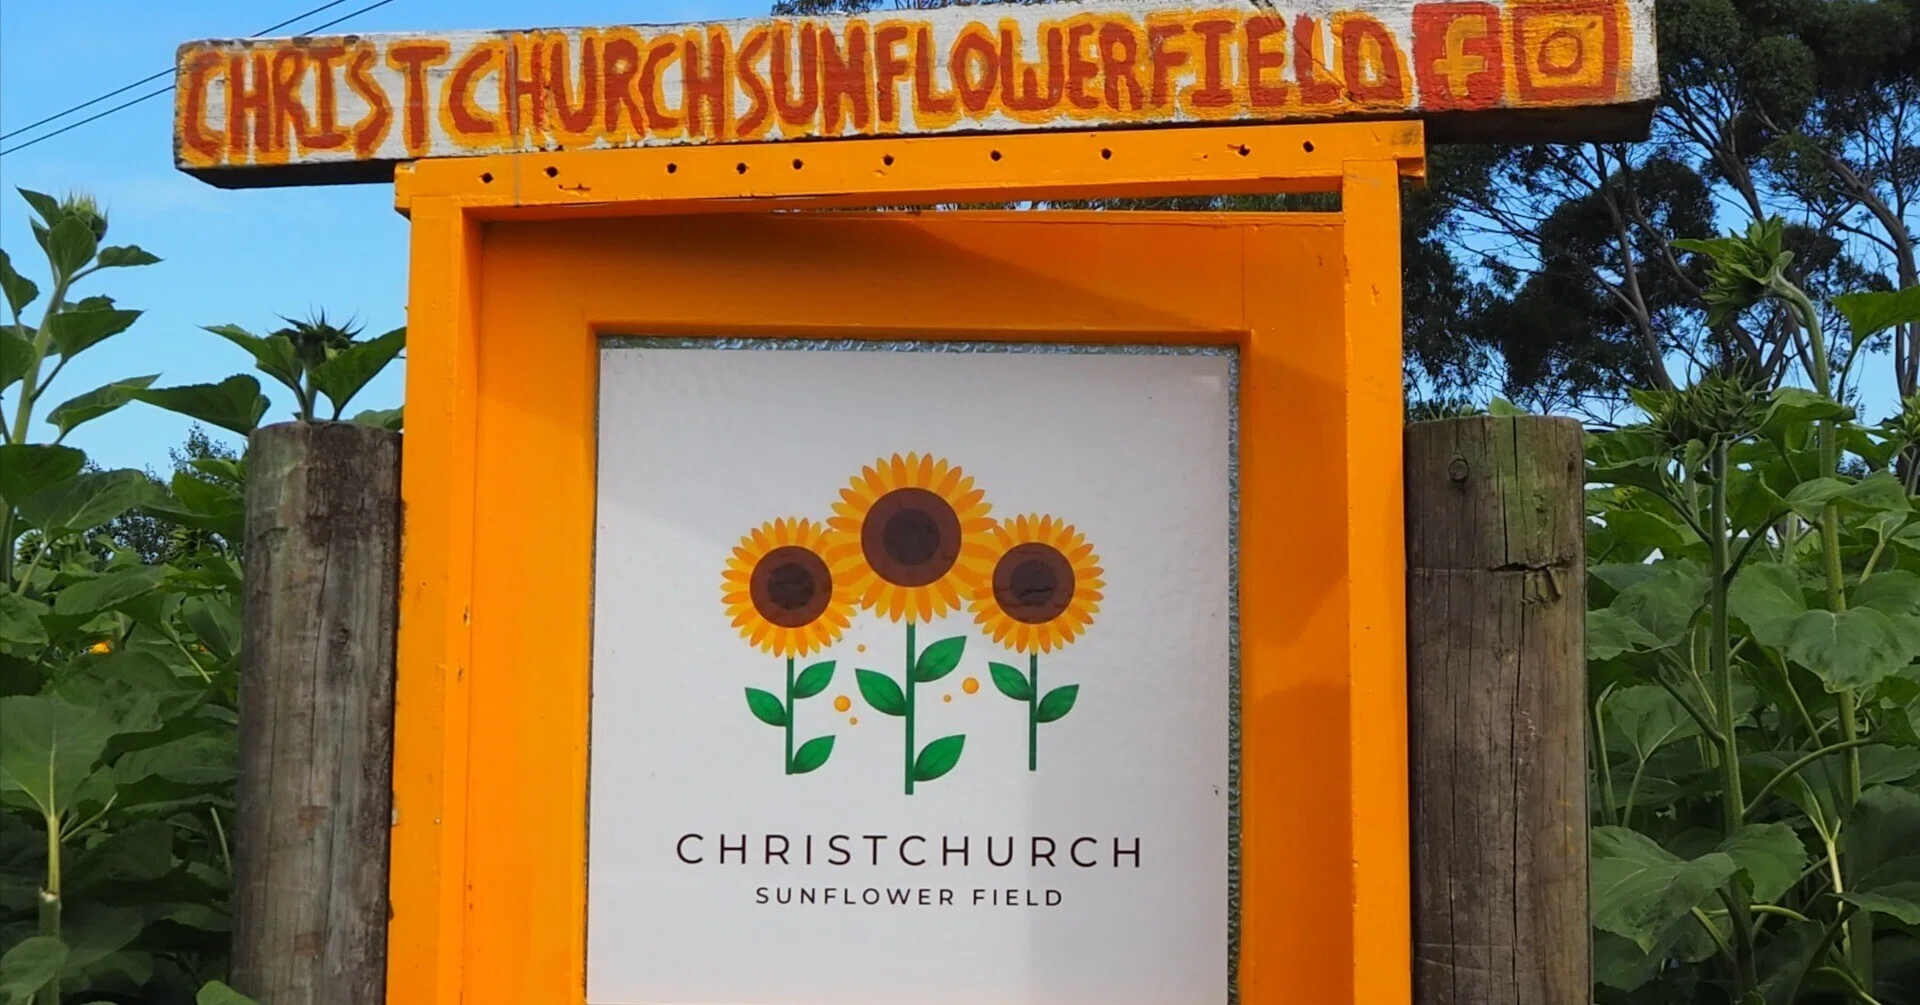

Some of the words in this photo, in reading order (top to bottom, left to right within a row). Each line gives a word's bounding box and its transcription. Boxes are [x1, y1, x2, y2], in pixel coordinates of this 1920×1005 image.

[676, 833, 1142, 868] CHRISTCHURCH
[755, 886, 954, 906] SUNFLOWER
[973, 888, 1063, 906] FIELD
